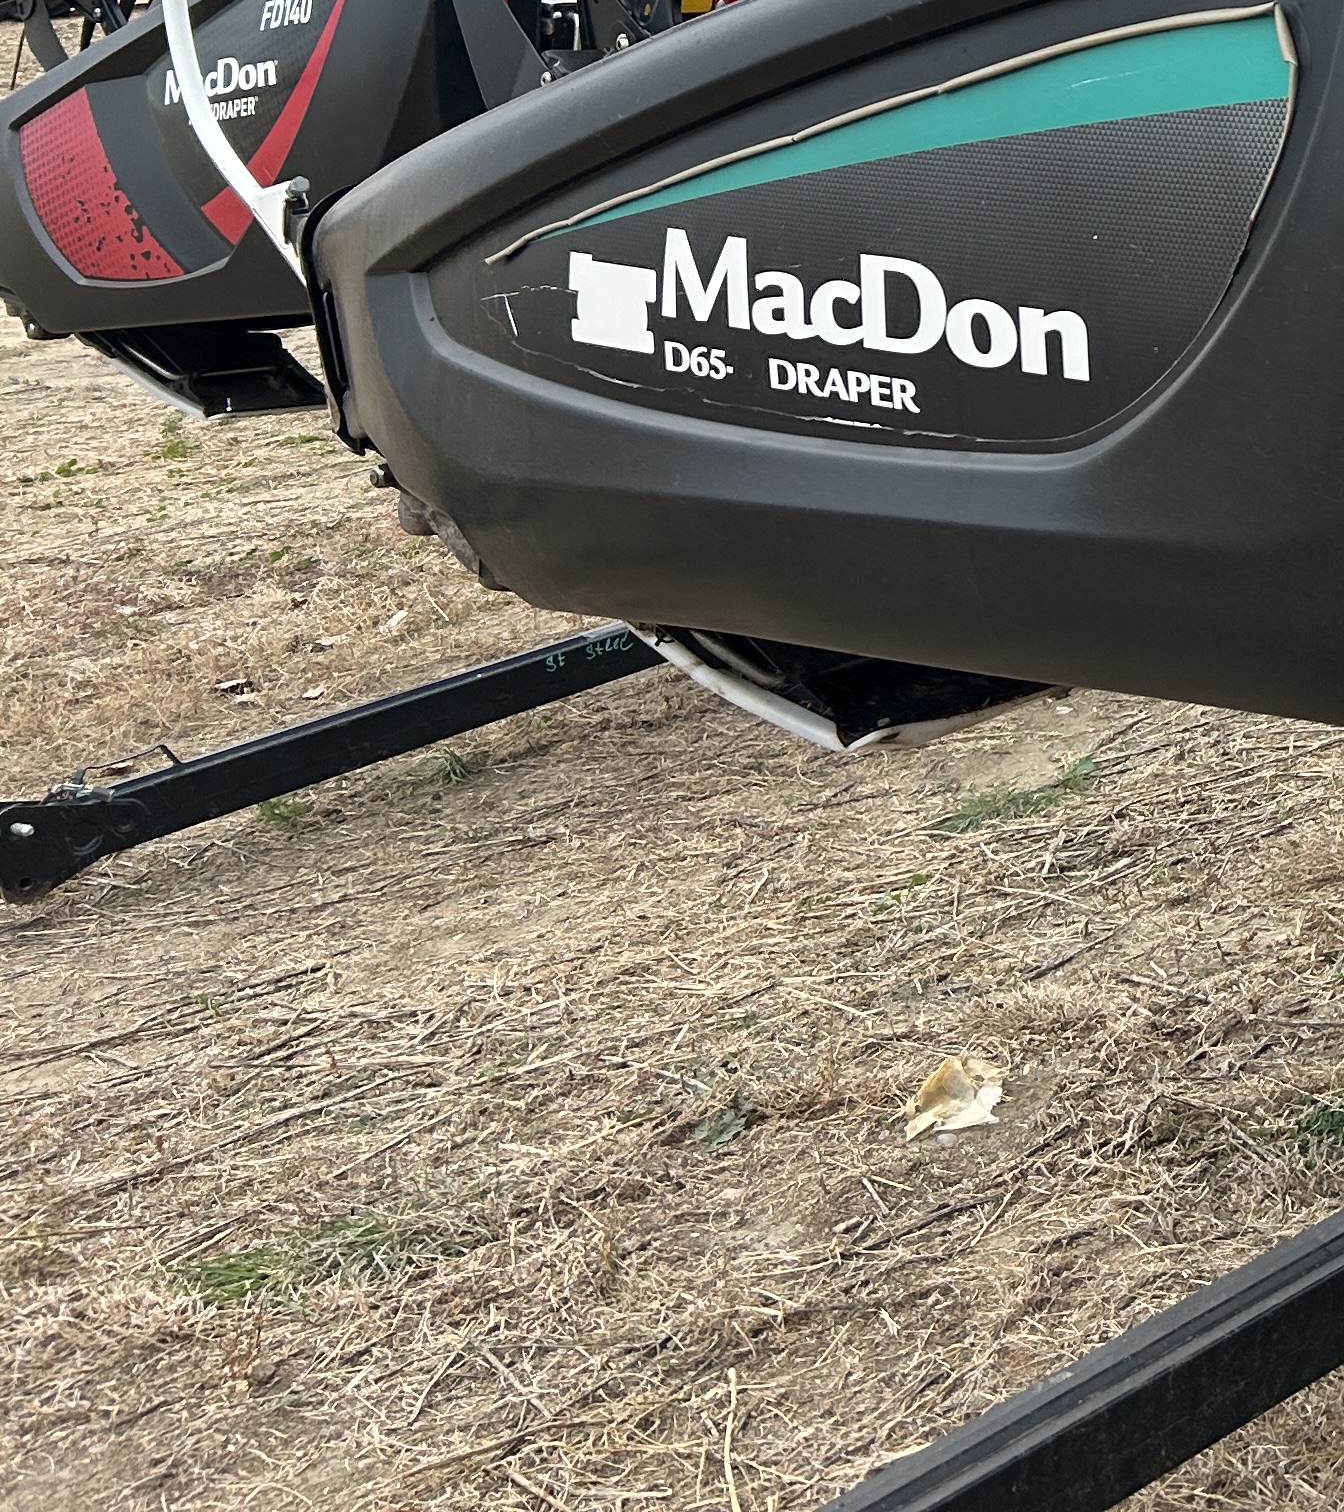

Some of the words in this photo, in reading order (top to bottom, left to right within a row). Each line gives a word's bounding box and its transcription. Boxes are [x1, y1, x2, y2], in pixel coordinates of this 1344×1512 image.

[164, 57, 278, 106] McDon
[661, 226, 1090, 382] MacDon
[769, 357, 920, 414] DRAPER
